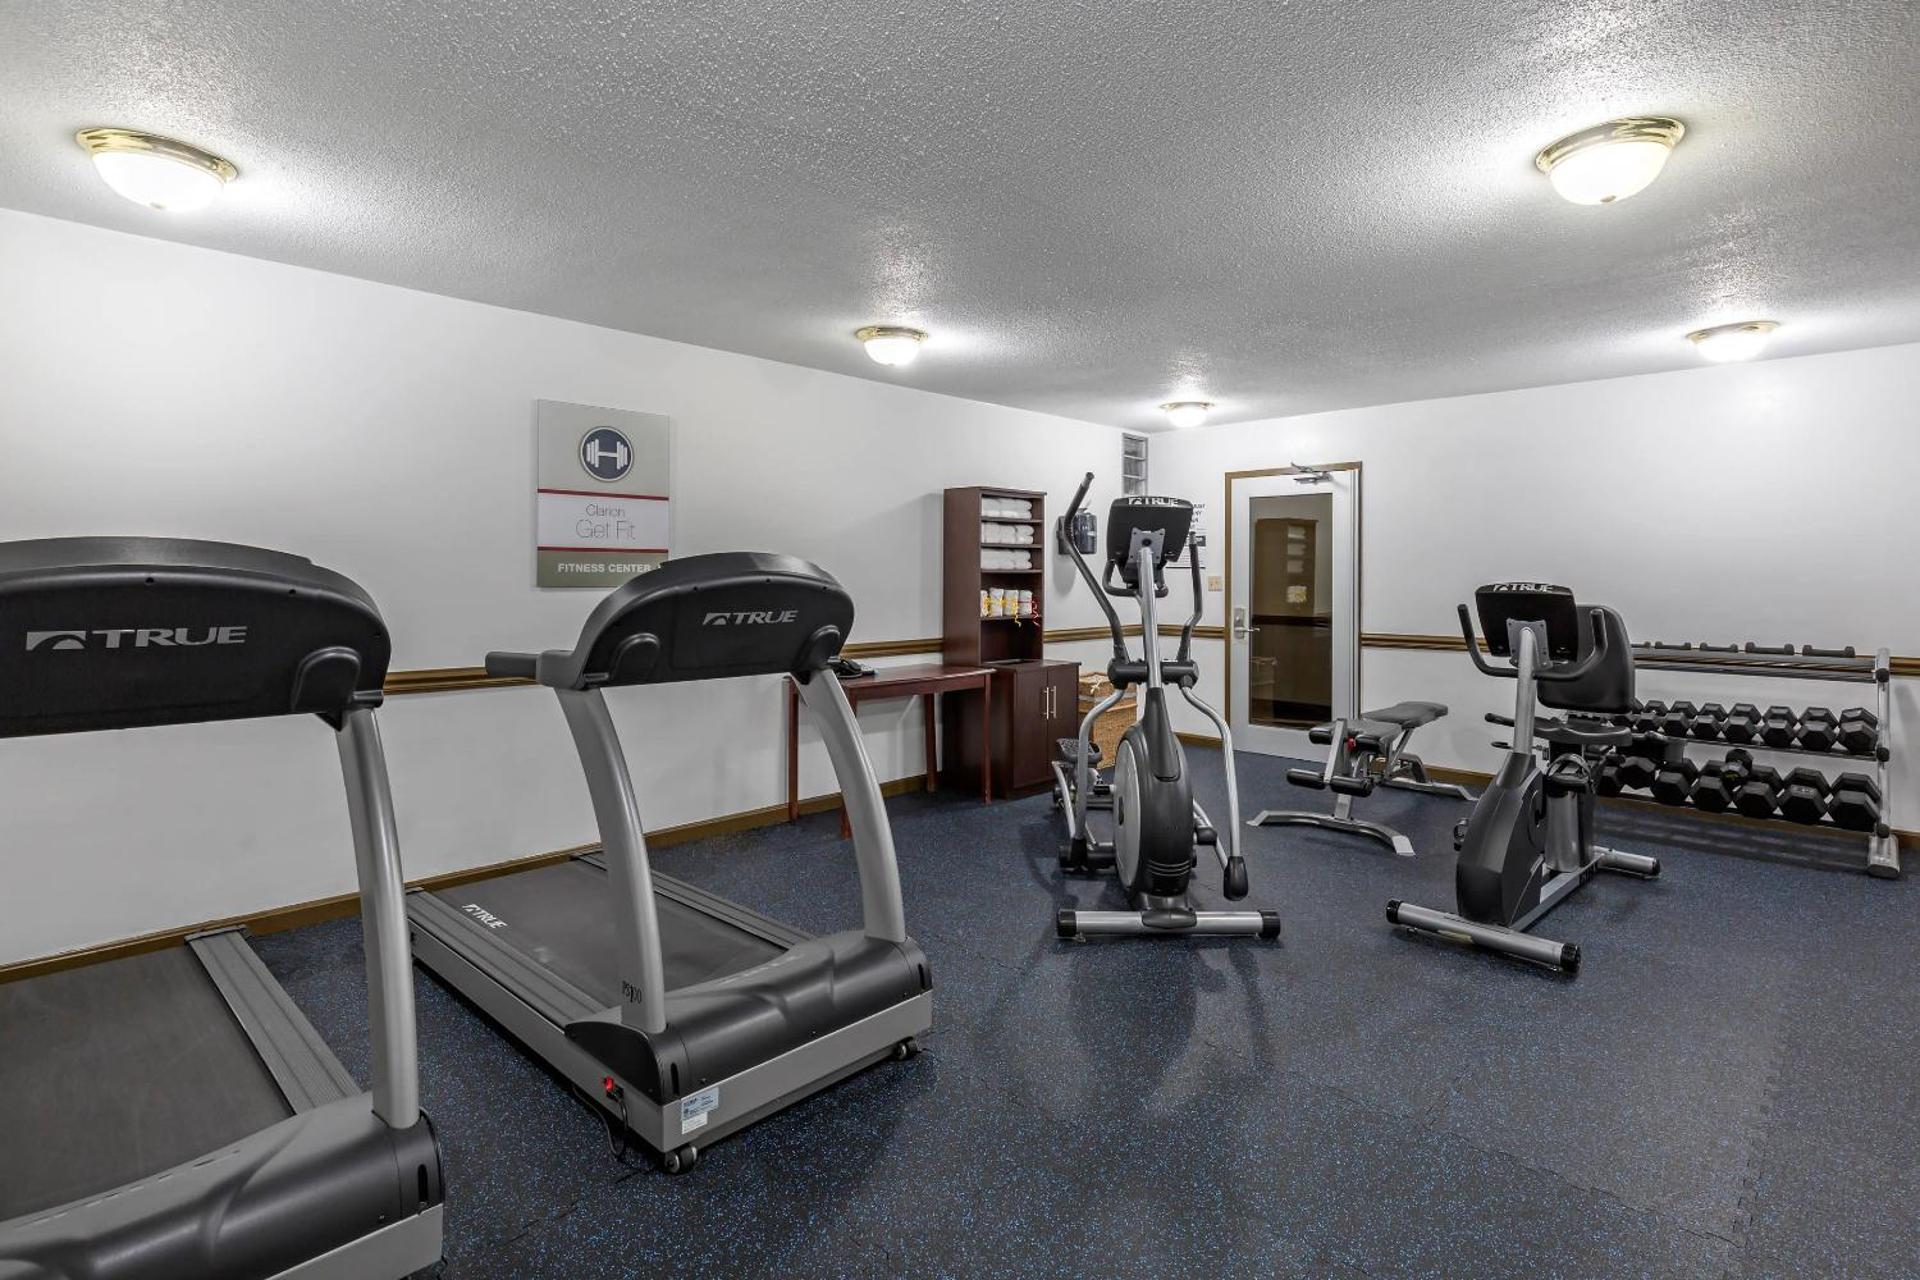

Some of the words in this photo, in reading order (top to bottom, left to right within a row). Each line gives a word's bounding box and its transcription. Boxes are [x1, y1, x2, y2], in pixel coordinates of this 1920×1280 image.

[585, 503, 626, 518] Clarion
[575, 518, 610, 539] Get
[616, 519, 636, 540] Fit
[557, 563, 606, 573] FITNESS
[608, 563, 651, 573] CENTER
[733, 610, 798, 625] TRUE
[92, 626, 248, 649] TRUE
